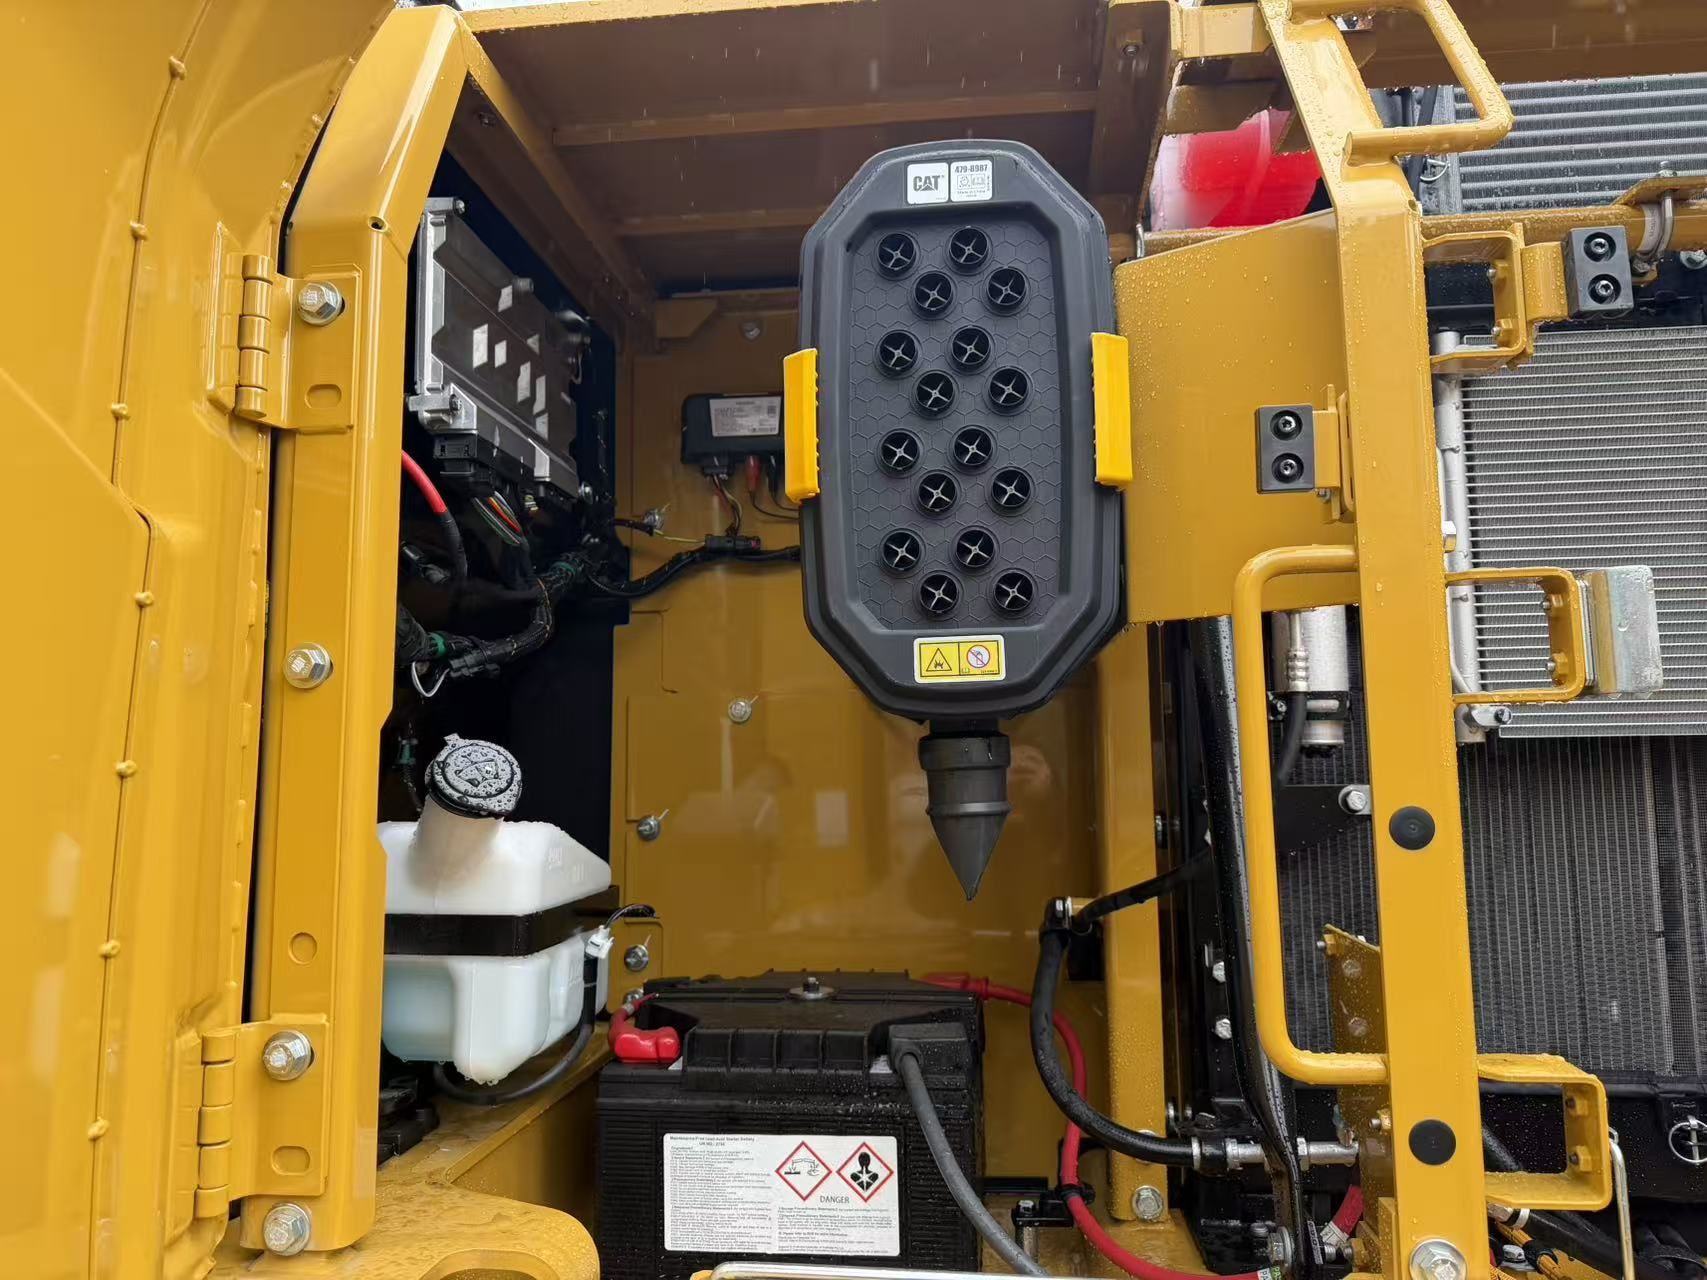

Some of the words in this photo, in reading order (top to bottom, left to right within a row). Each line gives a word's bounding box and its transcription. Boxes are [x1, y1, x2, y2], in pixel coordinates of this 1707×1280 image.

[955, 164, 988, 173] 479-8987
[913, 175, 940, 192] CAT
[819, 1195, 850, 1204] DANGER
